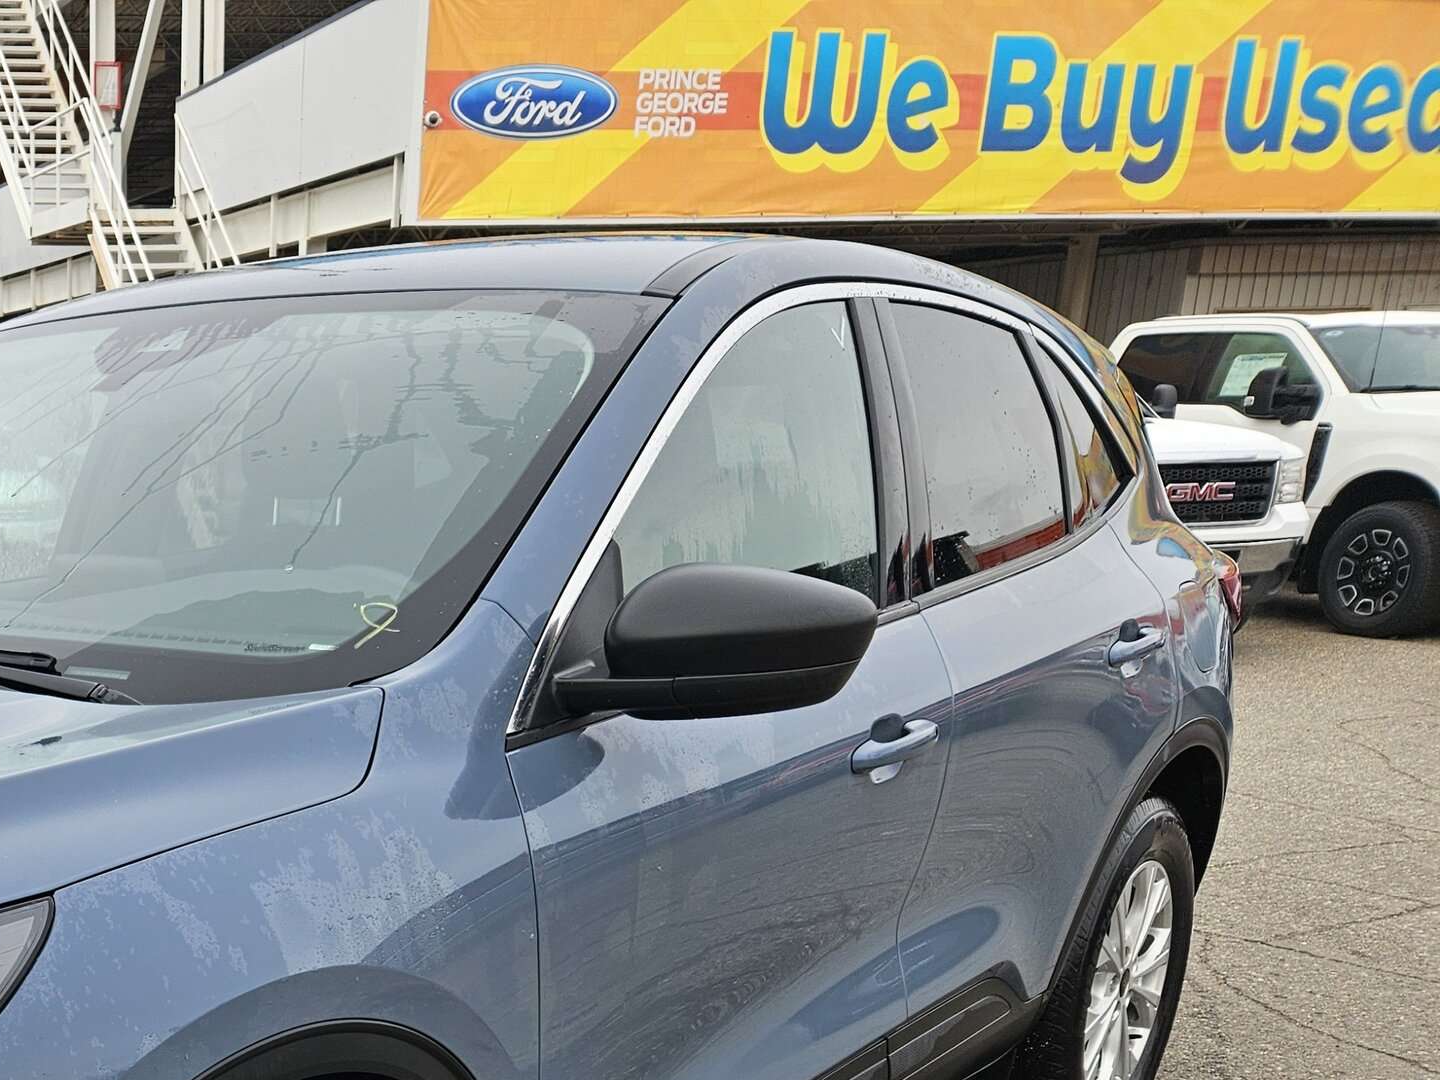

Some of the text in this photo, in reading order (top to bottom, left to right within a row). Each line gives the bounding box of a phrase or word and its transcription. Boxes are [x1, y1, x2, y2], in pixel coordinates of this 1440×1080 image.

[637, 68, 722, 90] PRINCE
[483, 76, 587, 127] Ford
[635, 91, 729, 114] GEORGE
[761, 28, 952, 158] We
[978, 33, 1197, 187] Buy
[633, 116, 697, 138] FORD
[1165, 481, 1236, 503] GMC
